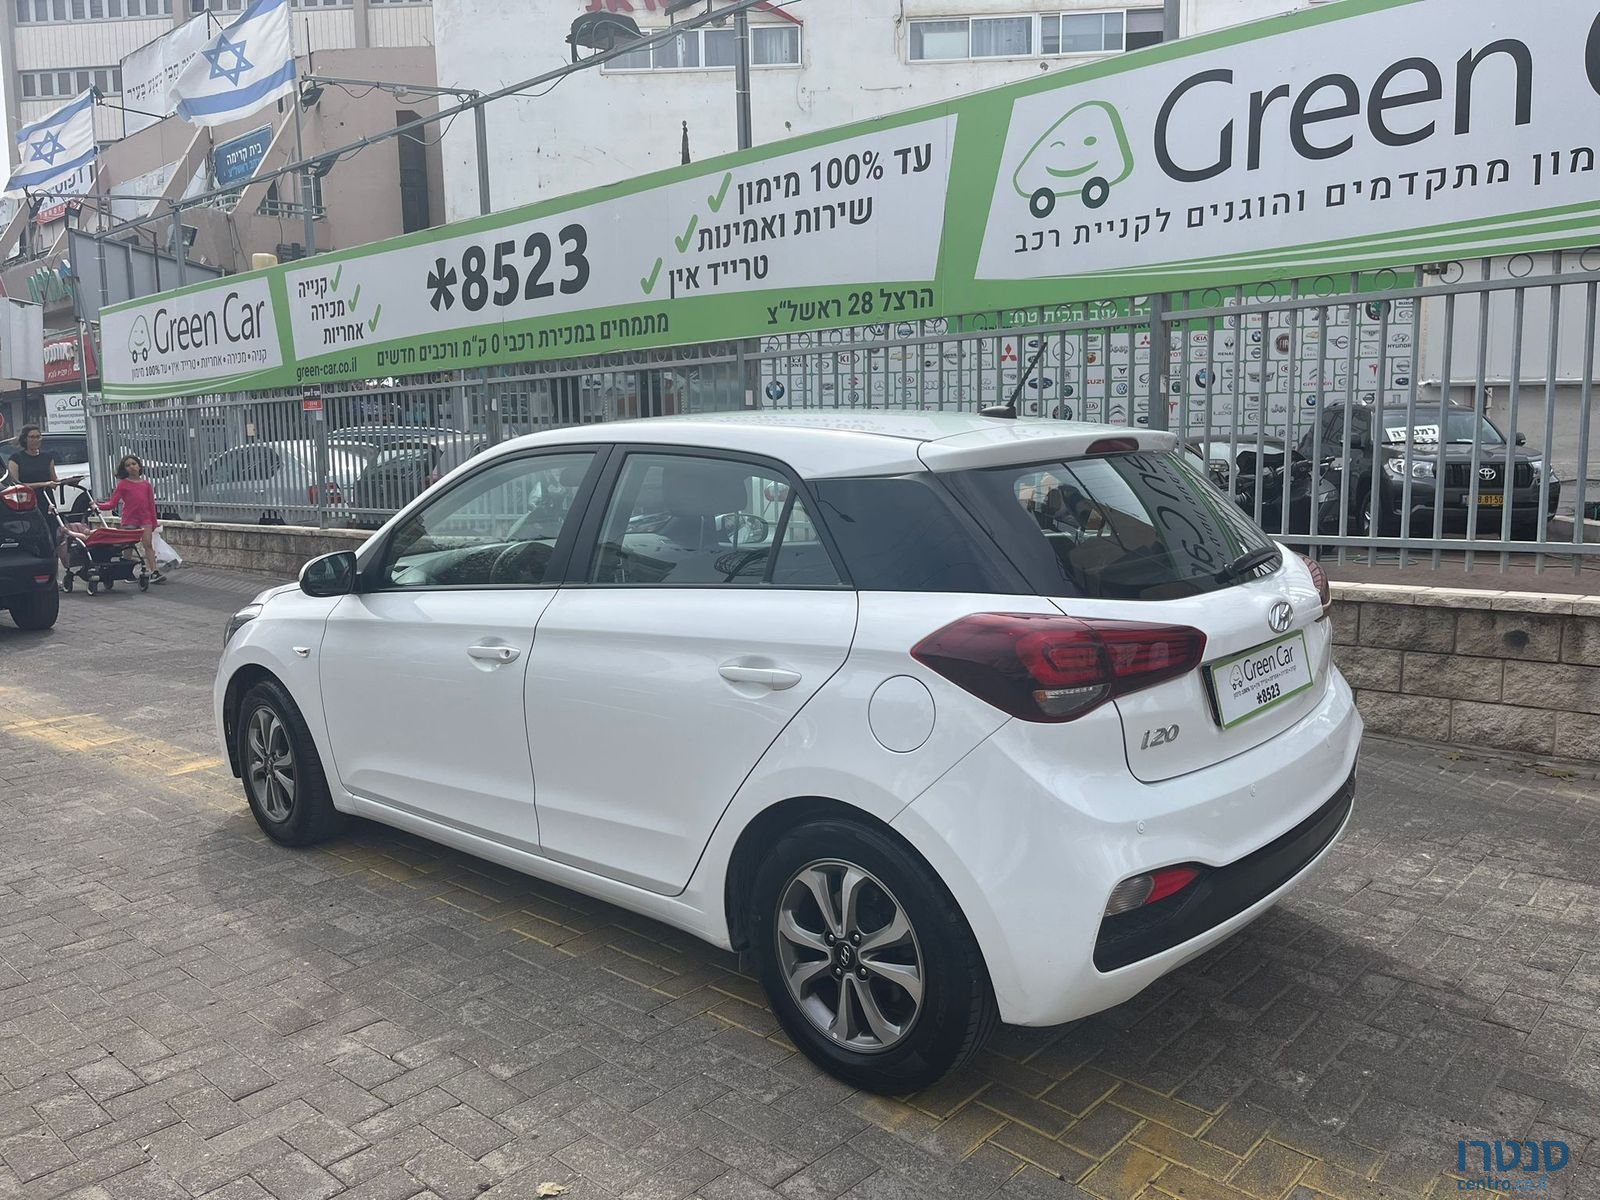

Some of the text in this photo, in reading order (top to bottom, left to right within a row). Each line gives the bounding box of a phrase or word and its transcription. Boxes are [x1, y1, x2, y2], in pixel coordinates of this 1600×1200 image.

[1153, 37, 1534, 183] Green
[249, 142, 262, 156] בית
[737, 142, 932, 215] עד 100% מימון
[1014, 146, 1594, 254] מון מתקדמים והוגנים לקניית רכב
[697, 196, 873, 252] שירות ואמינות
[298, 277, 328, 299] קנייה
[669, 254, 769, 299] טרייד אין
[311, 299, 345, 321] מכירה
[767, 287, 934, 324] הרצל 28 ראשל"צ
[153, 292, 265, 354] Green Car
[323, 322, 364, 345] אחריות
[600, 312, 669, 340] מתמחים
[491, 333, 500, 354] 0
[503, 331, 534, 352] רכבי
[538, 323, 596, 349] במכירת
[201, 355, 222, 369] אחריות
[227, 351, 247, 364] מכירה
[252, 349, 267, 363] קניה
[377, 347, 416, 367] חדשים
[419, 341, 458, 362] ורכבים
[145, 364, 160, 377] 100%
[297, 356, 357, 381] green-car.co.il
[1243, 645, 1293, 681] Green Car
[1140, 723, 1180, 750] i20
